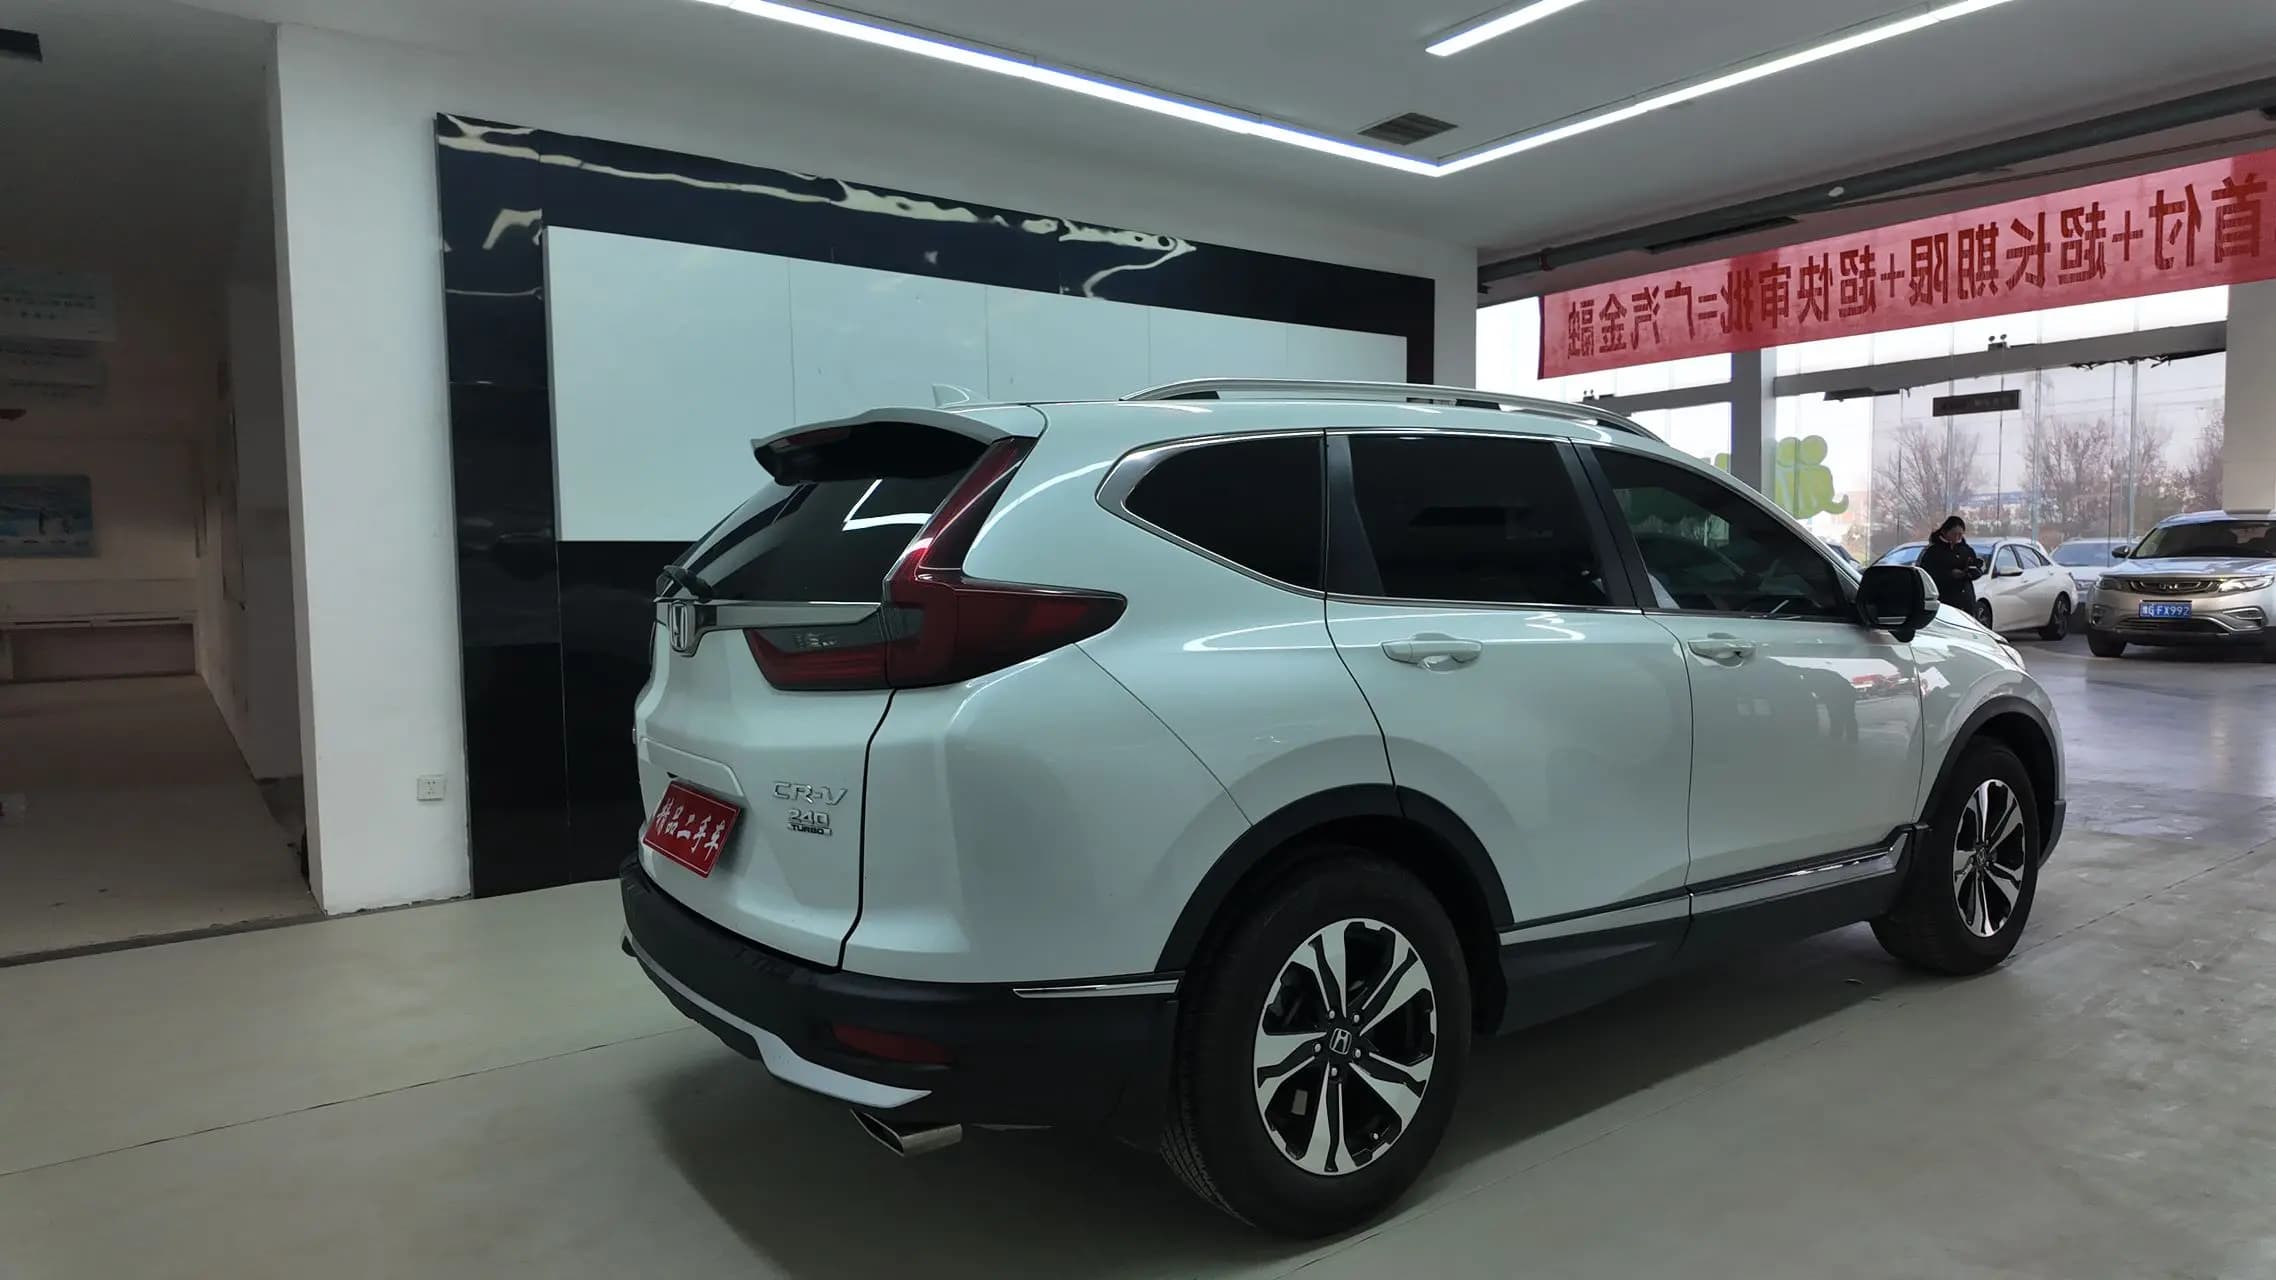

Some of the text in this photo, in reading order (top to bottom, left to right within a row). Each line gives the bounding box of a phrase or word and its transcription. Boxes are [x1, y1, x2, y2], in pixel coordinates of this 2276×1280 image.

[773, 782, 848, 806] CR-V
[787, 808, 831, 827] 240
[789, 824, 827, 836] TURBO
